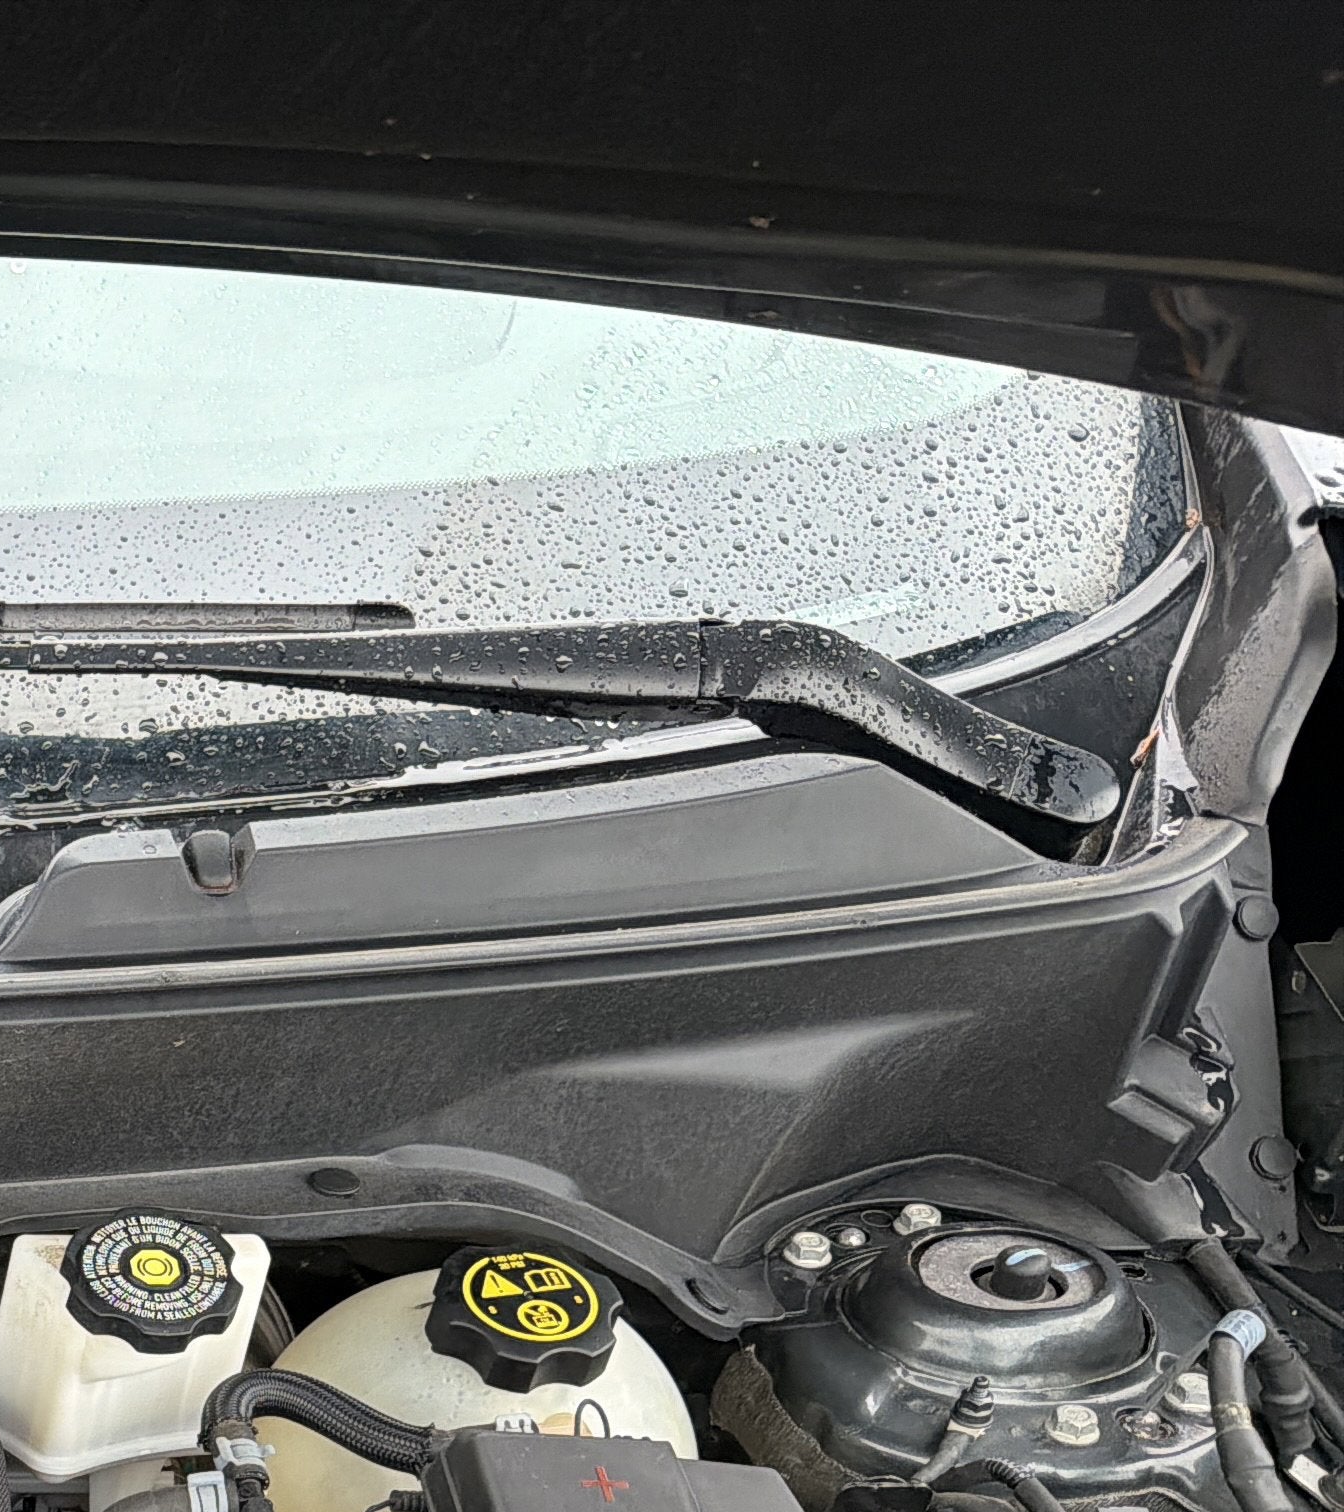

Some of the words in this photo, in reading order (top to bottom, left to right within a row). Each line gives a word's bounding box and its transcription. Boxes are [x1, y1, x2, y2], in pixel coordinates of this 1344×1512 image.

[126, 1216, 139, 1226] LE
[139, 1215, 181, 1231] BOUCHON
[181, 1225, 209, 1243] AVANT
[203, 1241, 216, 1253] LA
[100, 1276, 117, 1289] CAP
[112, 1287, 145, 1309] BEFORE
[154, 1290, 183, 1303] CLEAN
[129, 1305, 156, 1319] FROM
[163, 1306, 197, 1320] SEALED
